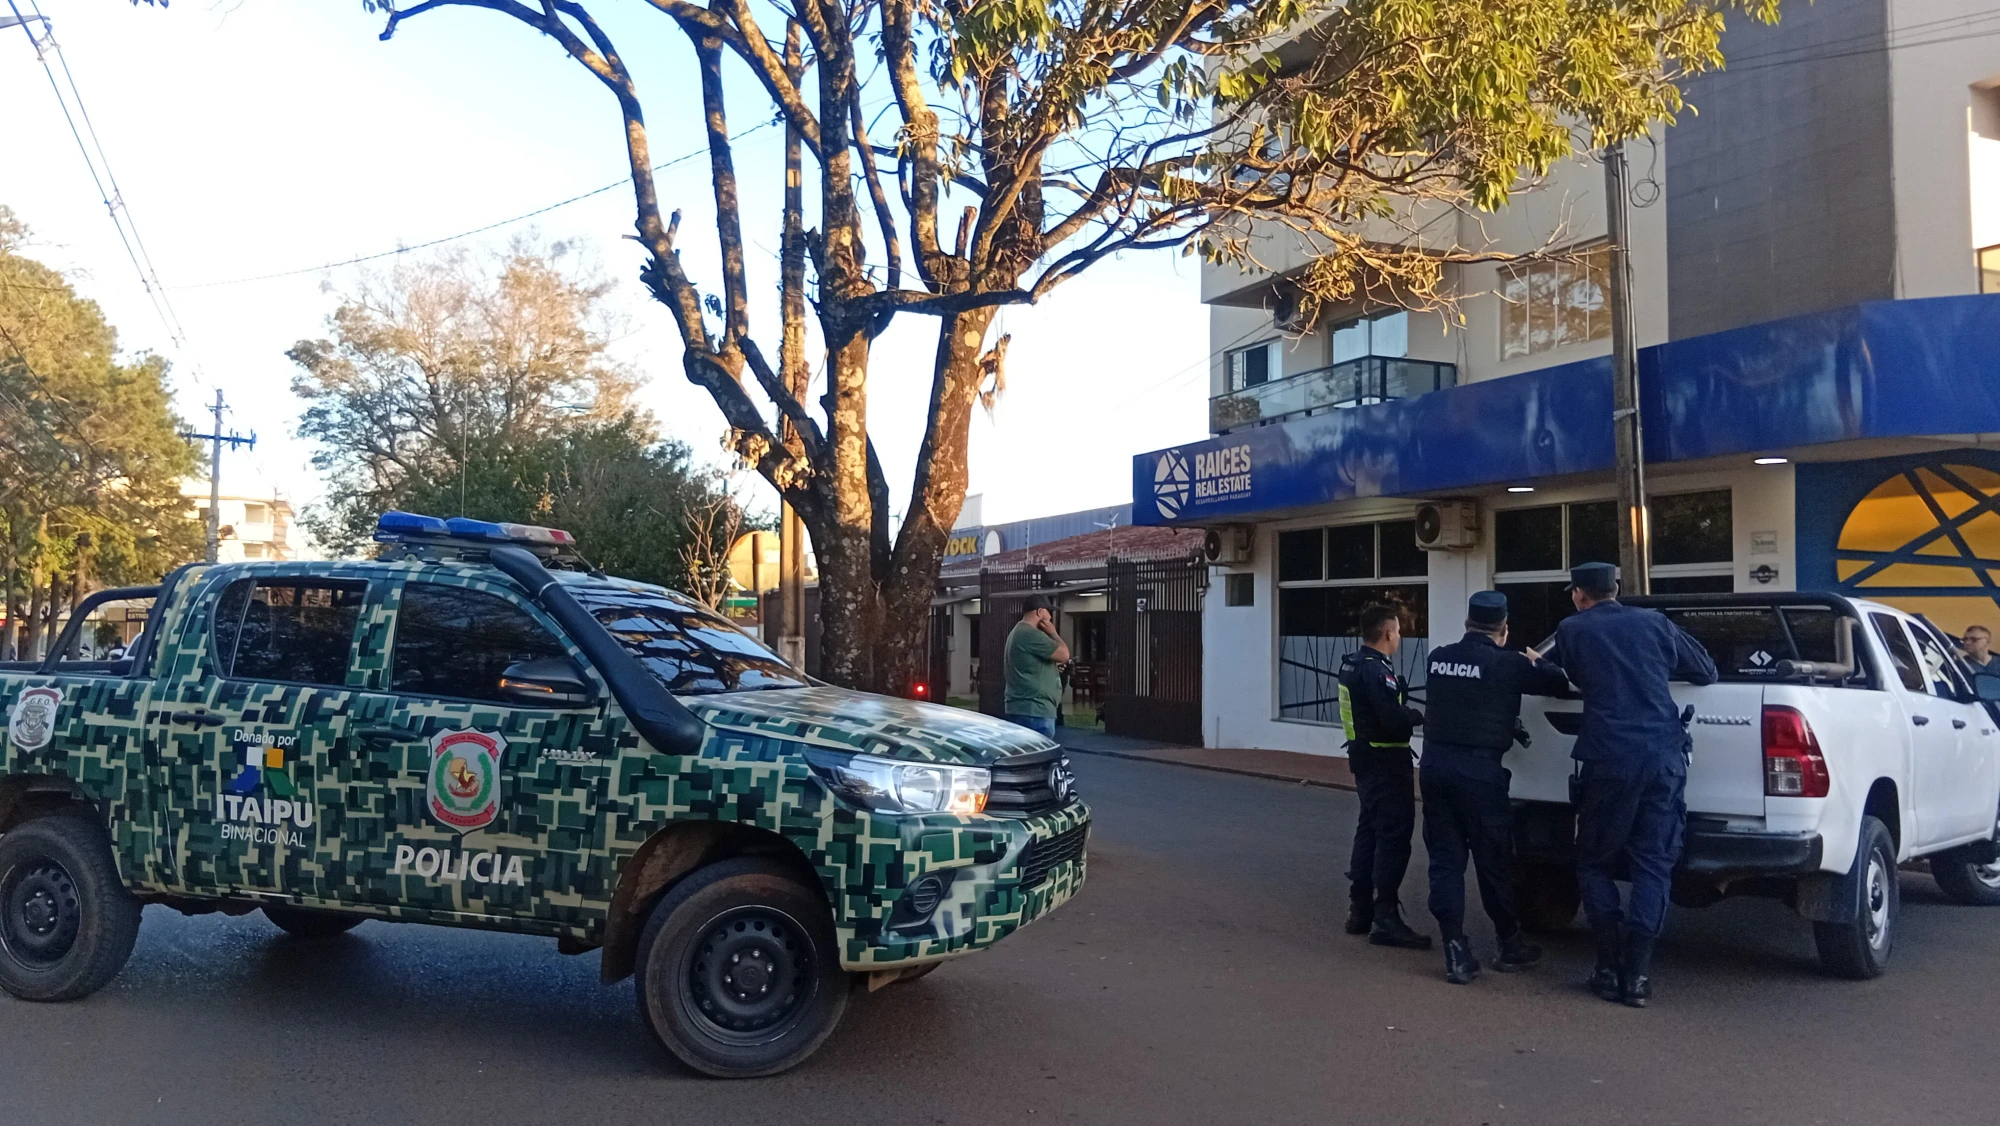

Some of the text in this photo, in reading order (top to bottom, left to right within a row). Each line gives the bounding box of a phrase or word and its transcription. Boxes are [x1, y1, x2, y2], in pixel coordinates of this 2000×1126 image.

[1195, 445, 1251, 480] RAICES
[1195, 474, 1251, 498] REAL ESTATE
[1430, 661, 1481, 679] POLICIA
[1696, 715, 1752, 726] HILUX
[234, 729, 297, 748] Donado por
[445, 735, 493, 747] POLICIA NACIONAL
[216, 794, 313, 828] ITAIPU
[221, 824, 307, 848] BINACIONAL
[394, 845, 525, 887] POLICIA
